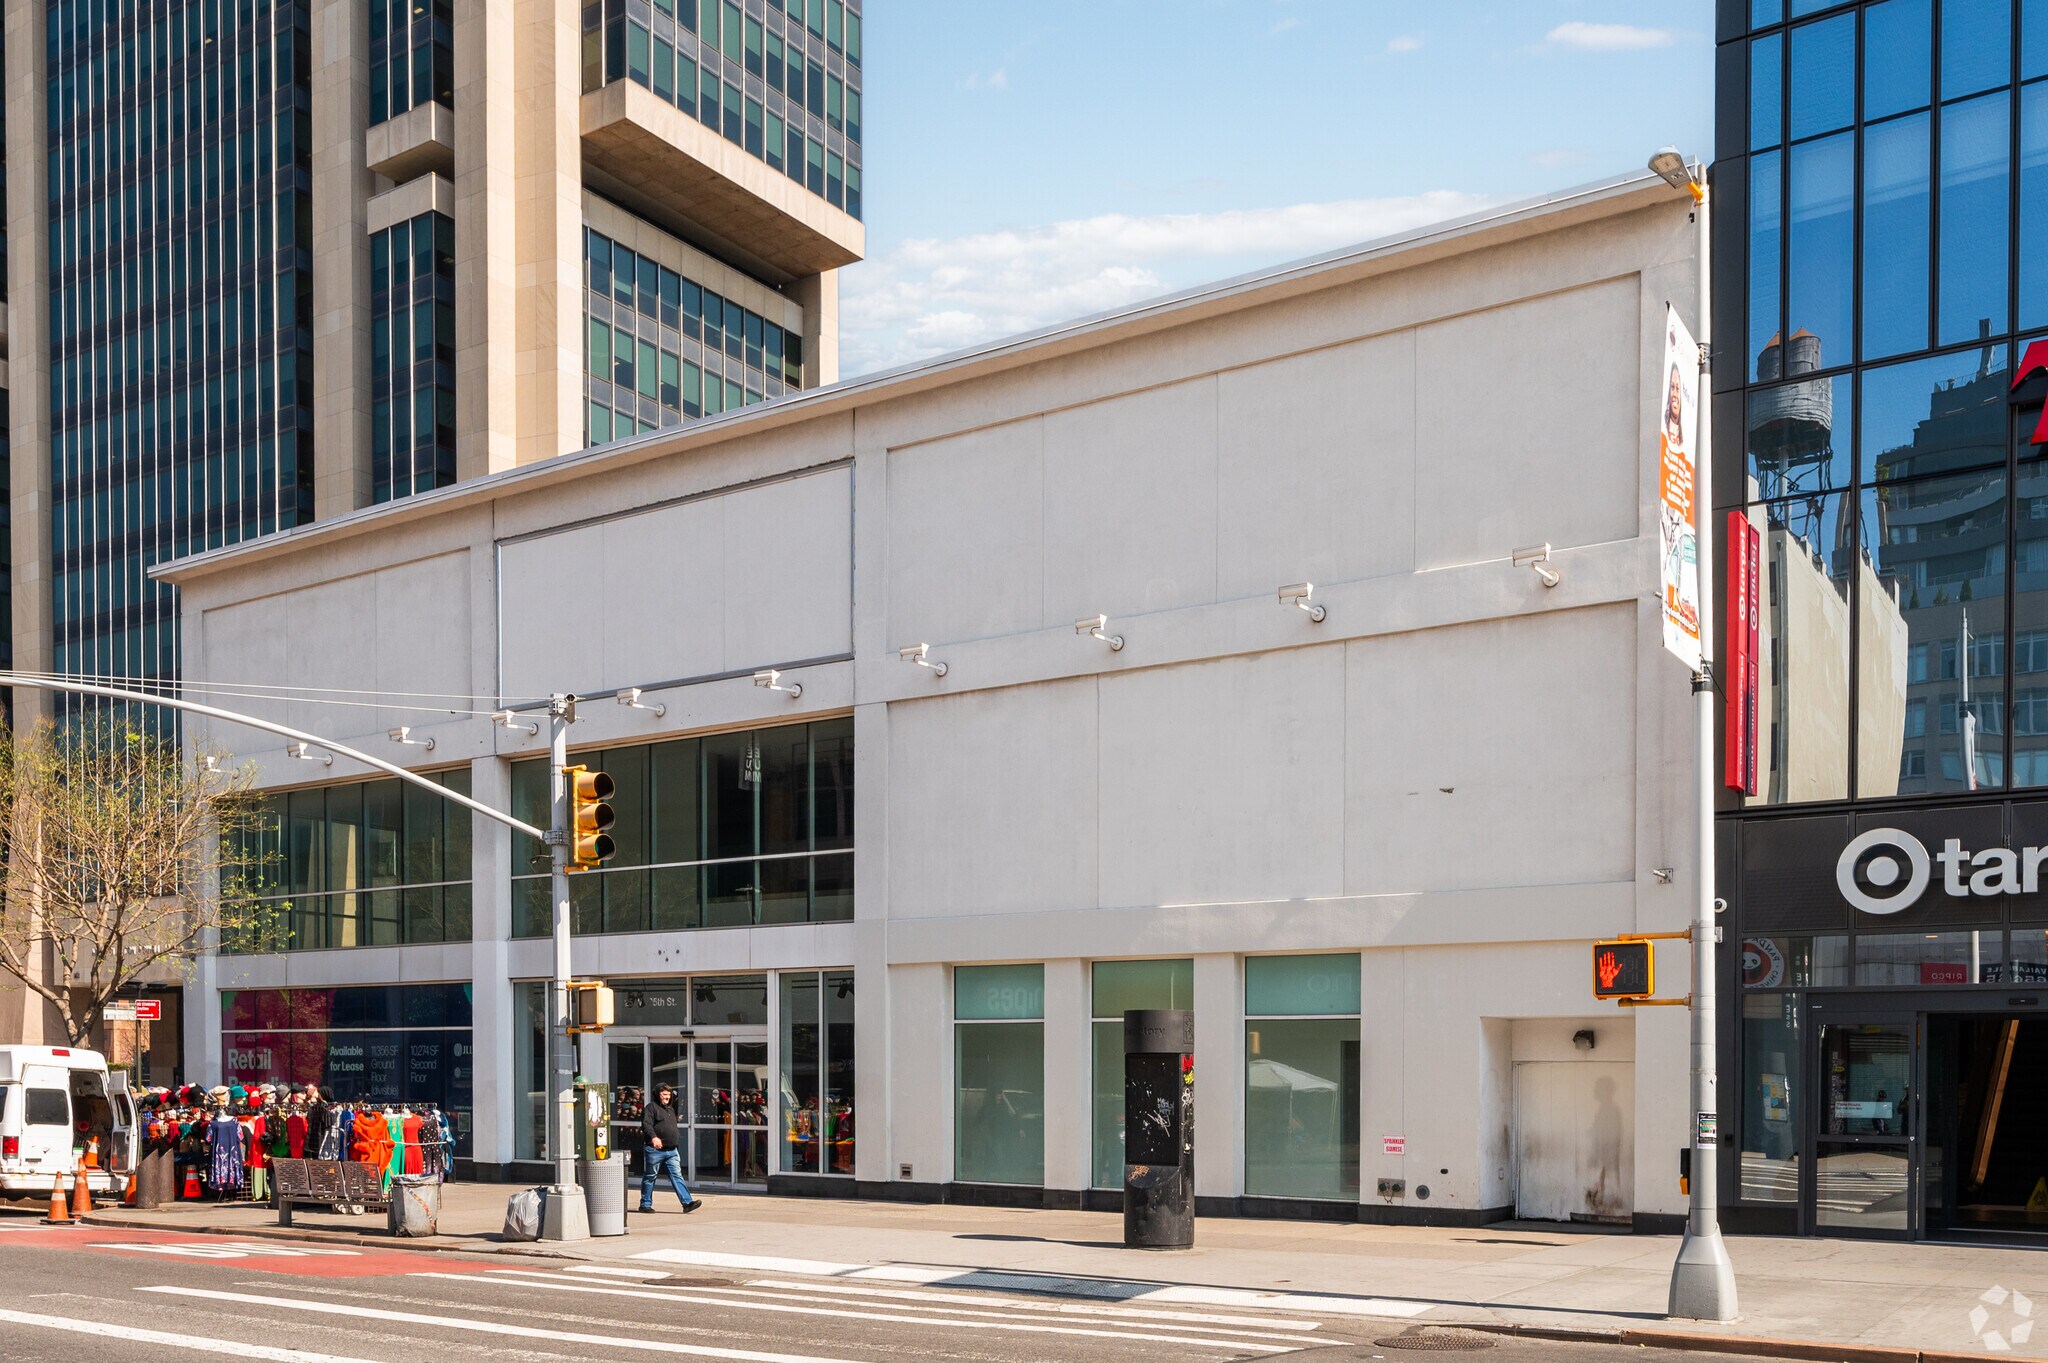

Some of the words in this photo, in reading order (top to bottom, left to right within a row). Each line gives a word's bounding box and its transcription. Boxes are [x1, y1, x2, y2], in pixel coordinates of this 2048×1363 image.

[330, 1045, 363, 1056] Available
[389, 1045, 399, 1056] SF
[429, 1045, 439, 1056] SF
[228, 1048, 272, 1070] Retail
[371, 1058, 395, 1069] Ground
[410, 1058, 437, 1069] Second
[330, 1061, 341, 1072] for
[341, 1061, 364, 1072] Lease
[371, 1071, 387, 1082] Floor
[410, 1071, 427, 1082] Floor
